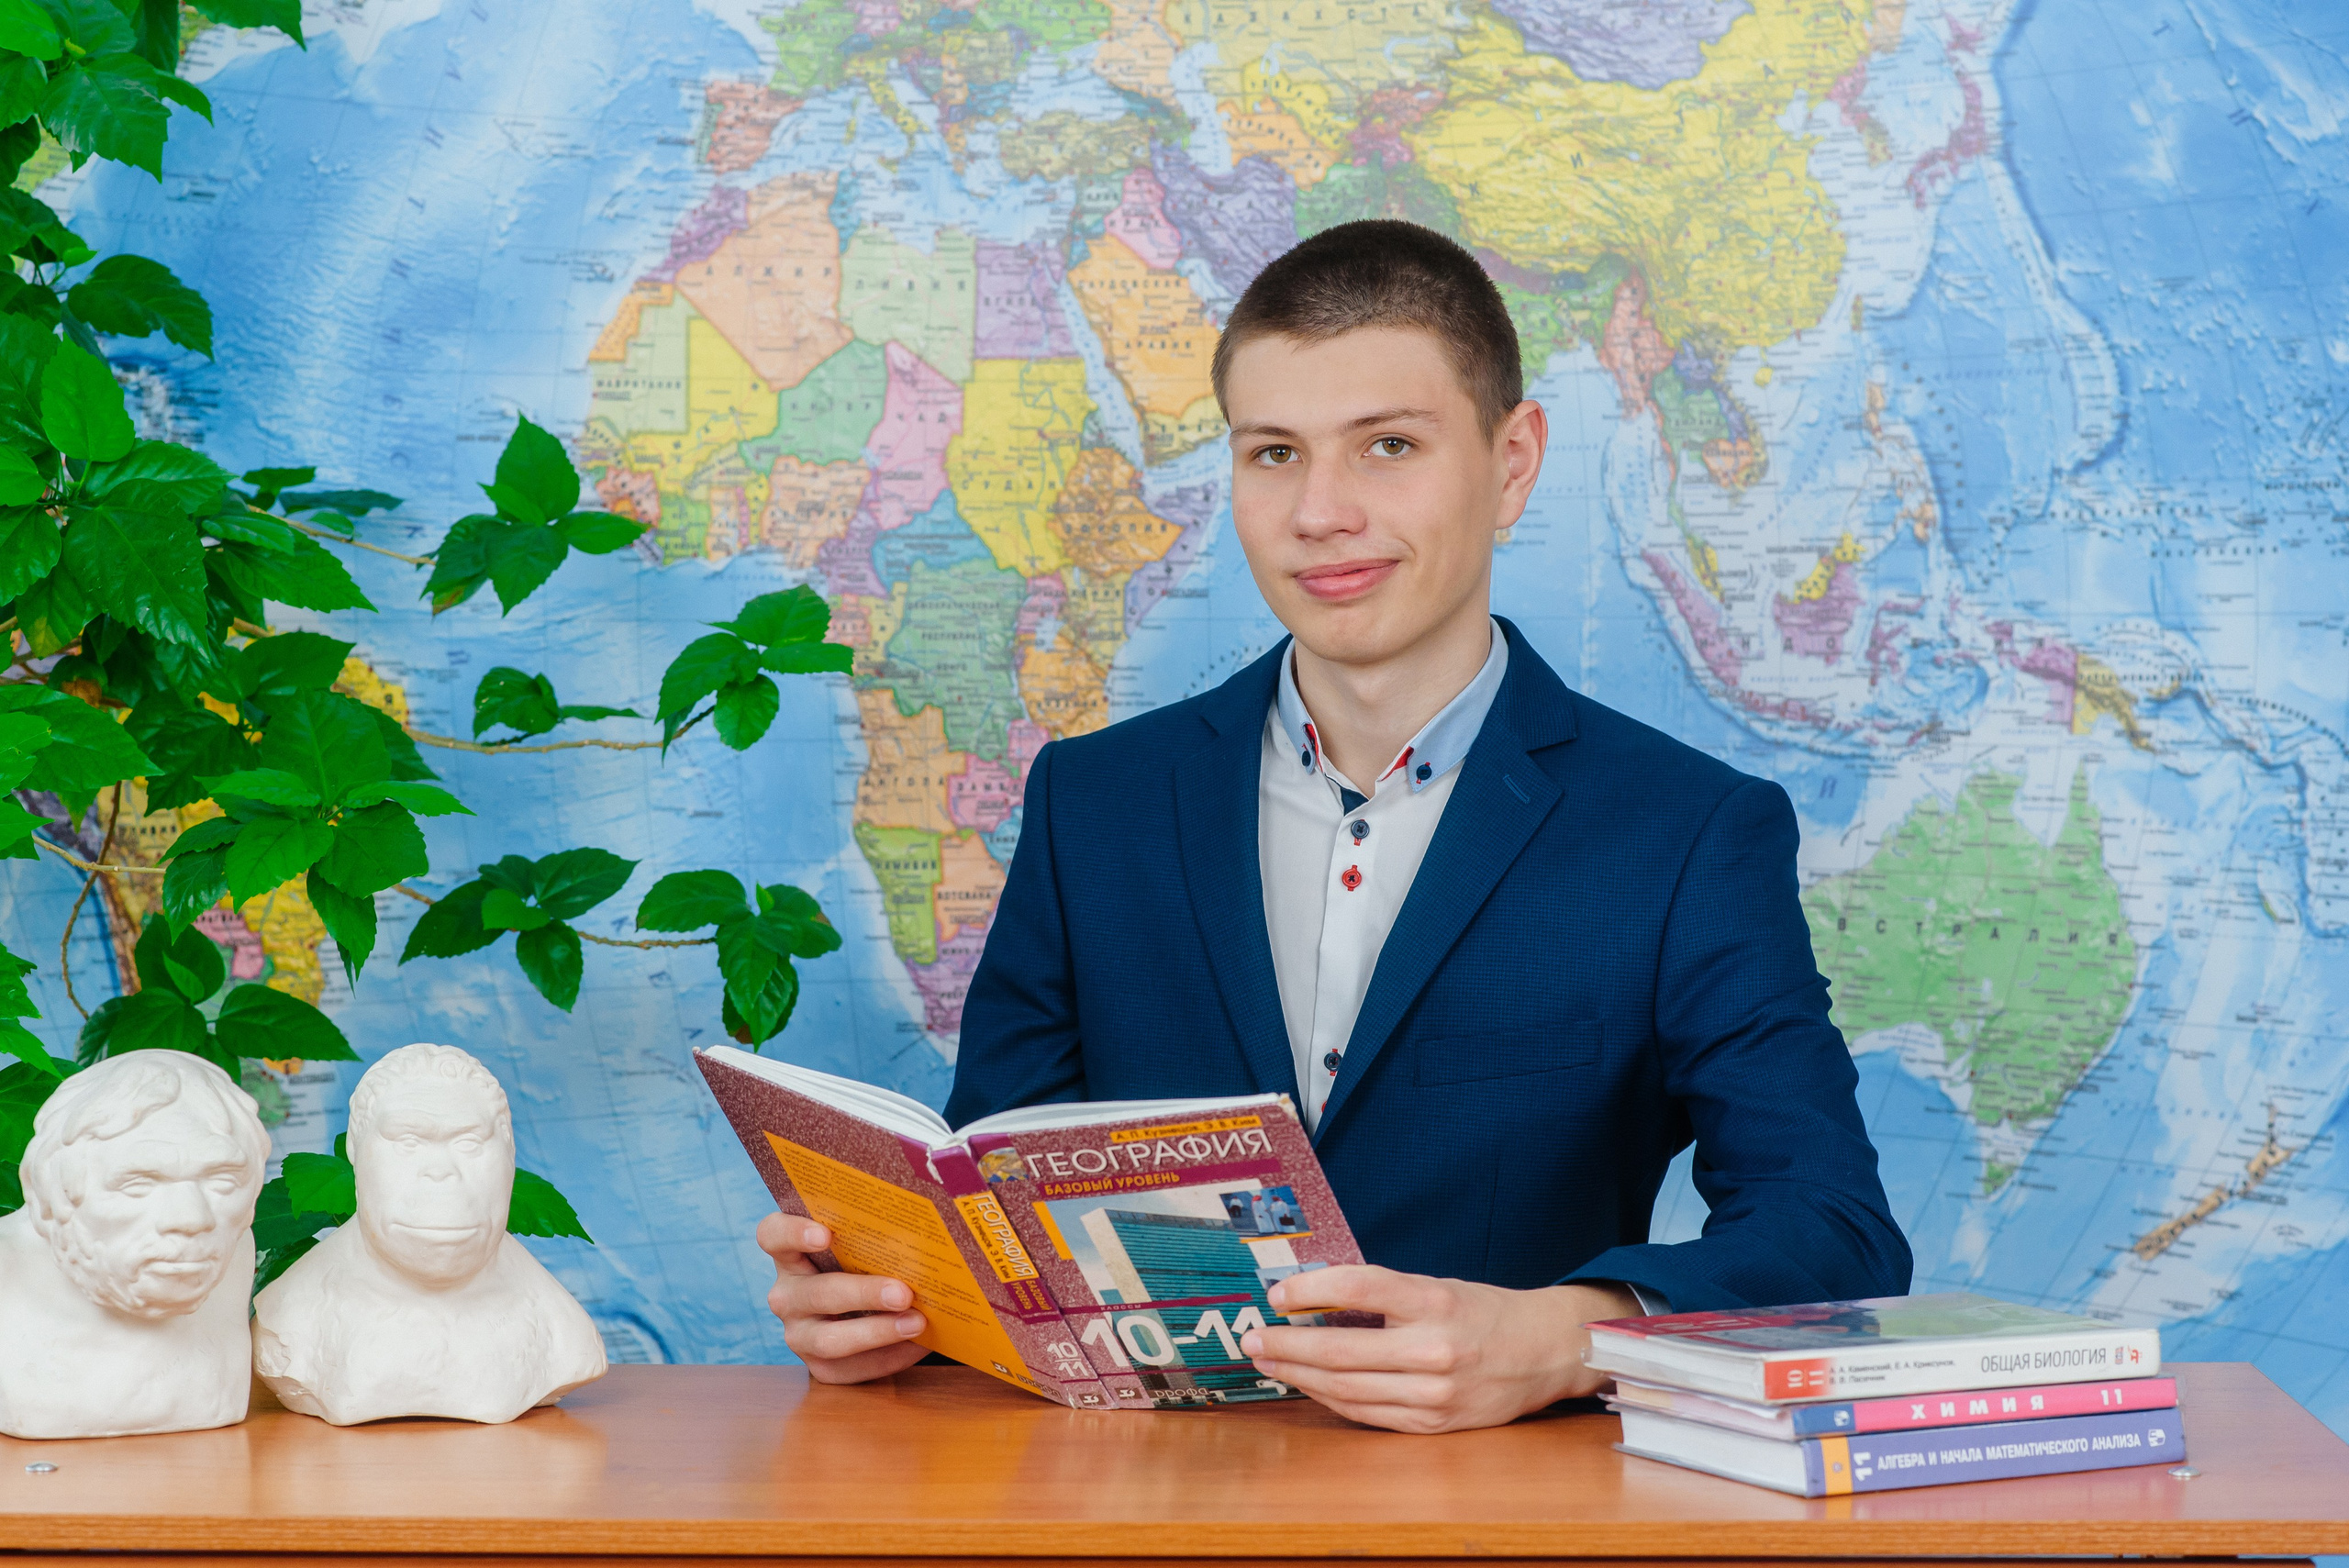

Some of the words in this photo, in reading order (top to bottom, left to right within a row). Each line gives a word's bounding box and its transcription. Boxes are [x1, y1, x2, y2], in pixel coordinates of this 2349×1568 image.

[1026, 1128, 1274, 1179] ГЕОГРАФИЯ
[1044, 1175, 1113, 1195] БАЗОВЫЙ
[1116, 1171, 1181, 1190] УРОВЕНЬ
[973, 1195, 1035, 1278] ГЕОГРАФИЯ
[1010, 1281, 1034, 1311] УРОВЕНЬ
[1025, 1279, 1052, 1312] БАЗОВЫЙ
[1047, 1341, 1079, 1360] 10
[1980, 1353, 2031, 1373] ОБЩАЯ
[2034, 1348, 2107, 1369] БИОЛОГИЯ
[1058, 1362, 1089, 1378] 11
[1911, 1395, 2044, 1420] ХИМИЯ
[2100, 1388, 2123, 1407] 11
[1853, 1452, 1874, 1482] 11
[1877, 1452, 1926, 1471] АЛГЕБРА
[1928, 1450, 1938, 1465] И
[1940, 1447, 1984, 1465] НАЧАЛА
[1986, 1437, 2089, 1461] МАТЕМАТИЧЕСКОГО
[2091, 1433, 2142, 1451] АНАЛИЗА
